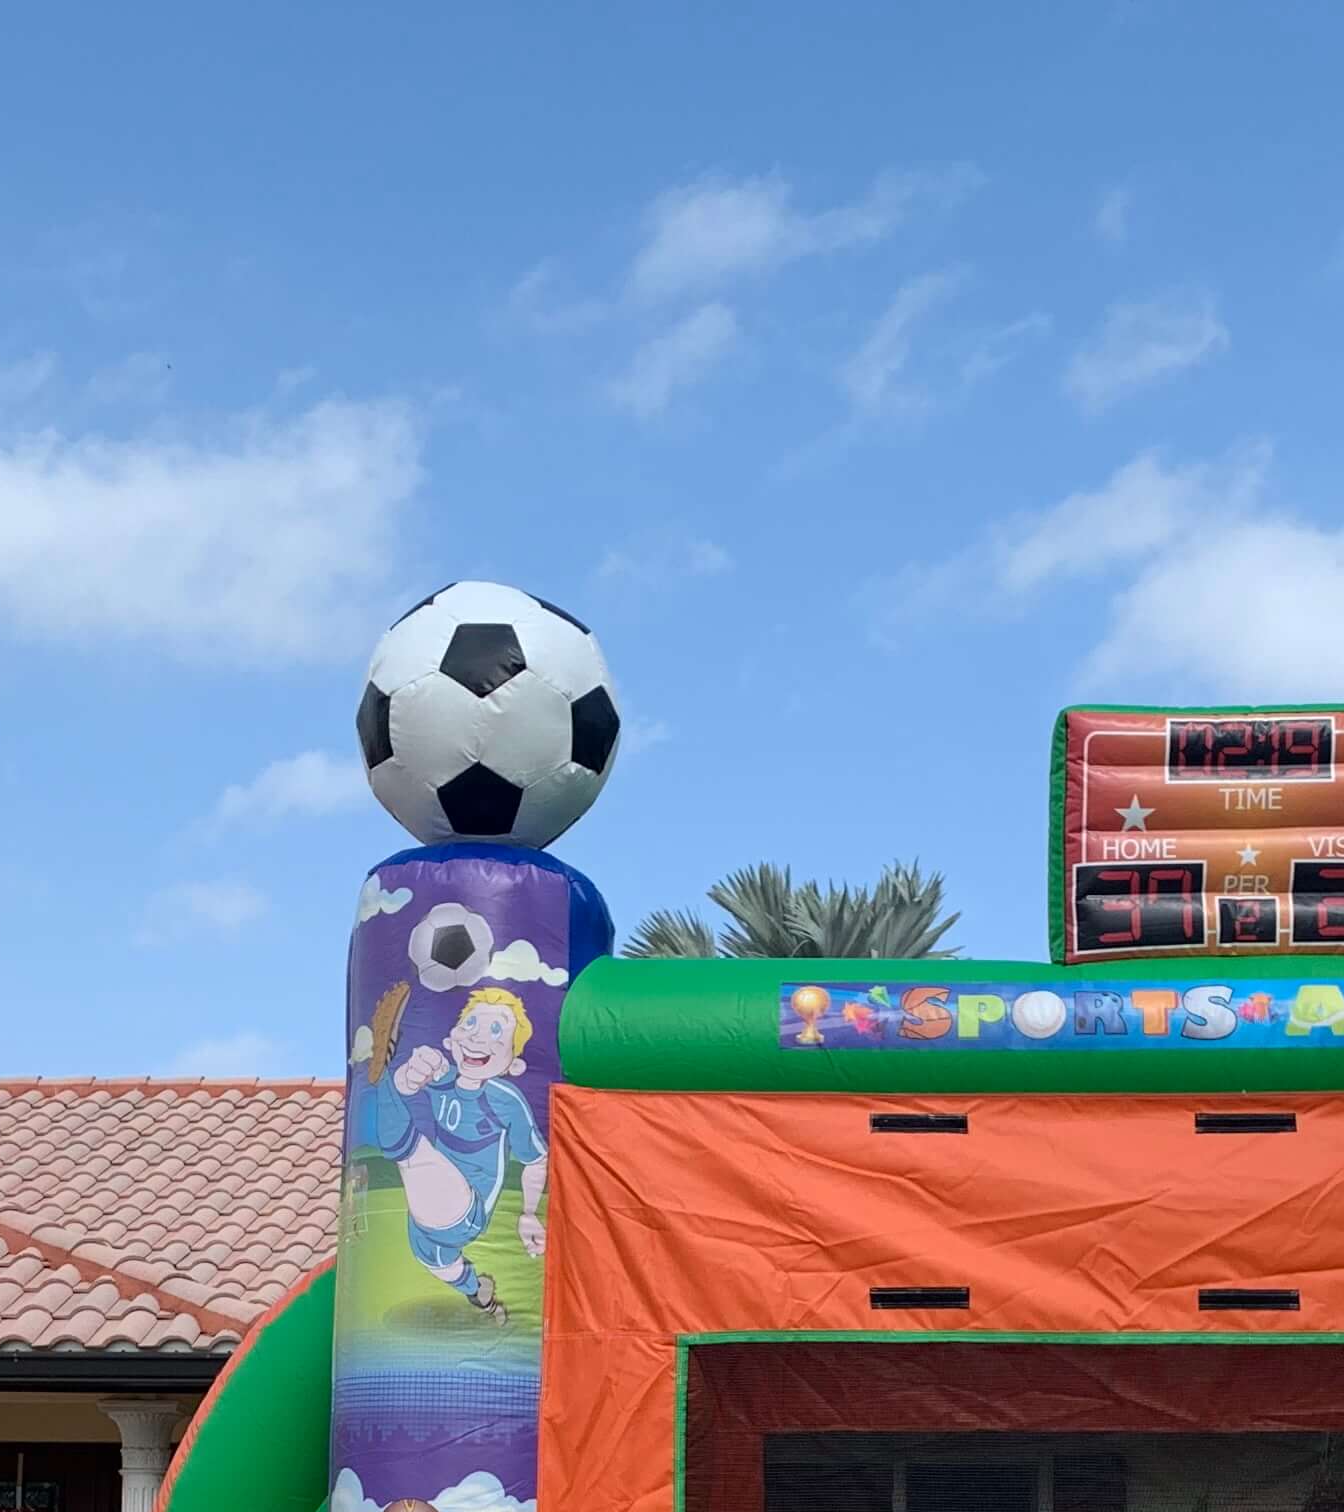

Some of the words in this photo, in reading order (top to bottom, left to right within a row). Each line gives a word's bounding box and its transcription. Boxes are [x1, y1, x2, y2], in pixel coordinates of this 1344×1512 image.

[1177, 722, 1320, 777] 02:19
[1219, 787, 1283, 810] TIME
[1102, 839, 1177, 860] HOME
[1223, 875, 1271, 895] PER
[1234, 899, 1260, 941] 2
[897, 985, 1238, 1041] SPORTS
[438, 1095, 462, 1131] 10
